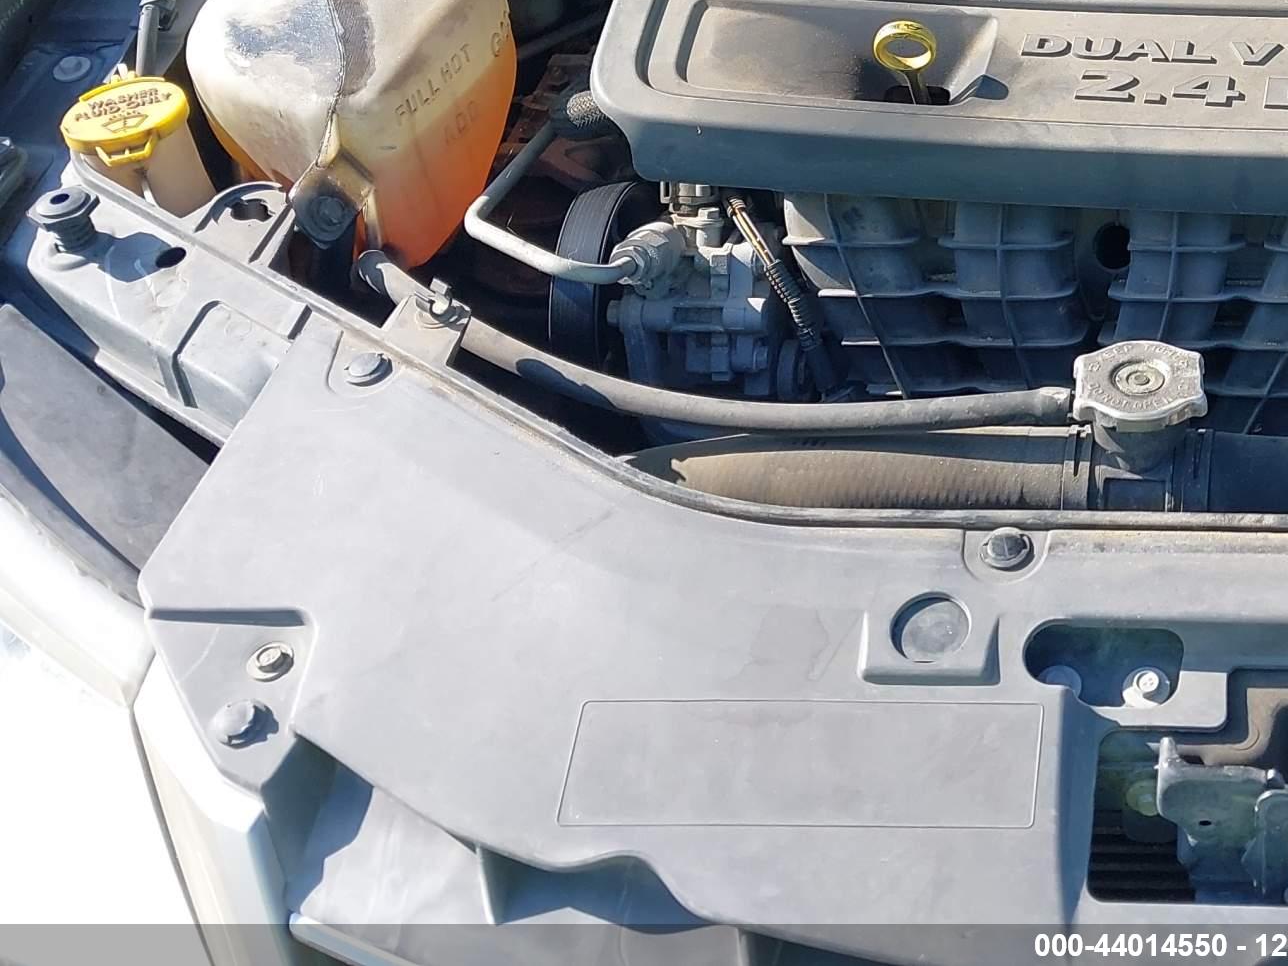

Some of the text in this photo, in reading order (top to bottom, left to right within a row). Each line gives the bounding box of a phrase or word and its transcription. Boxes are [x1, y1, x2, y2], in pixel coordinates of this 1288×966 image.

[1020, 33, 1218, 65] DUAL
[88, 87, 159, 109] WASHER
[394, 42, 472, 127] FULL HOT
[75, 92, 172, 122] FLUID ONLY
